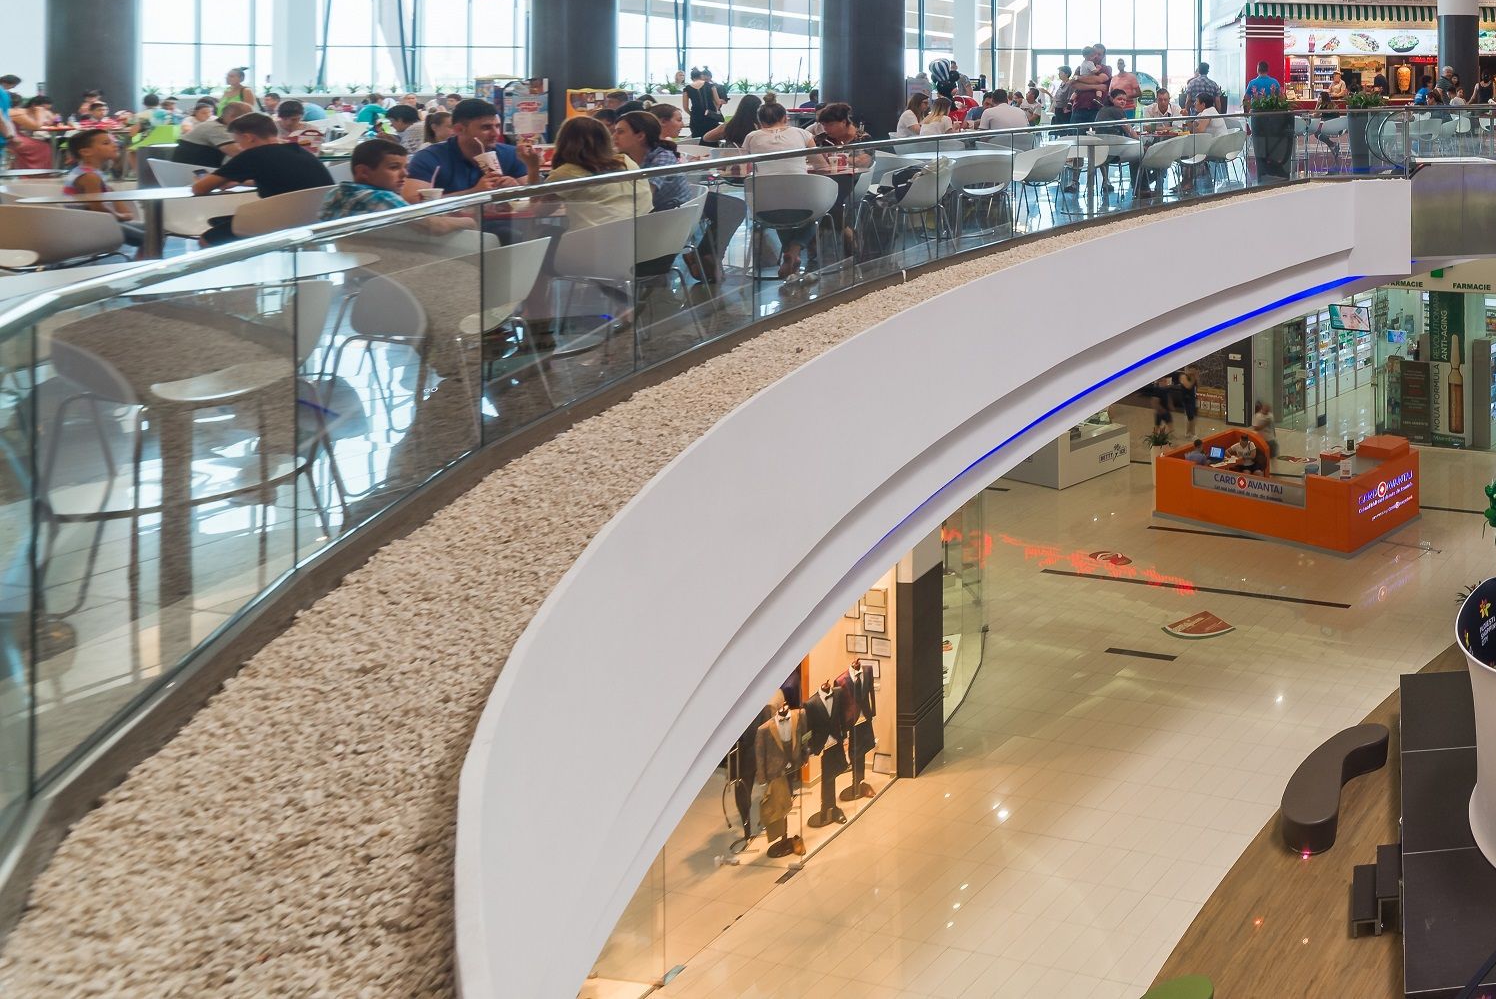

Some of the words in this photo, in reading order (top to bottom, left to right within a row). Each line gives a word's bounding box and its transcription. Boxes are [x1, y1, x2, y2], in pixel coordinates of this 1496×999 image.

[1453, 282, 1491, 291] FARMACIE
[1433, 407, 1441, 431] NOUA
[1214, 473, 1236, 485] CARD
[1247, 480, 1283, 495] AVANTAJ
[1480, 615, 1495, 633] PLOIESTI
